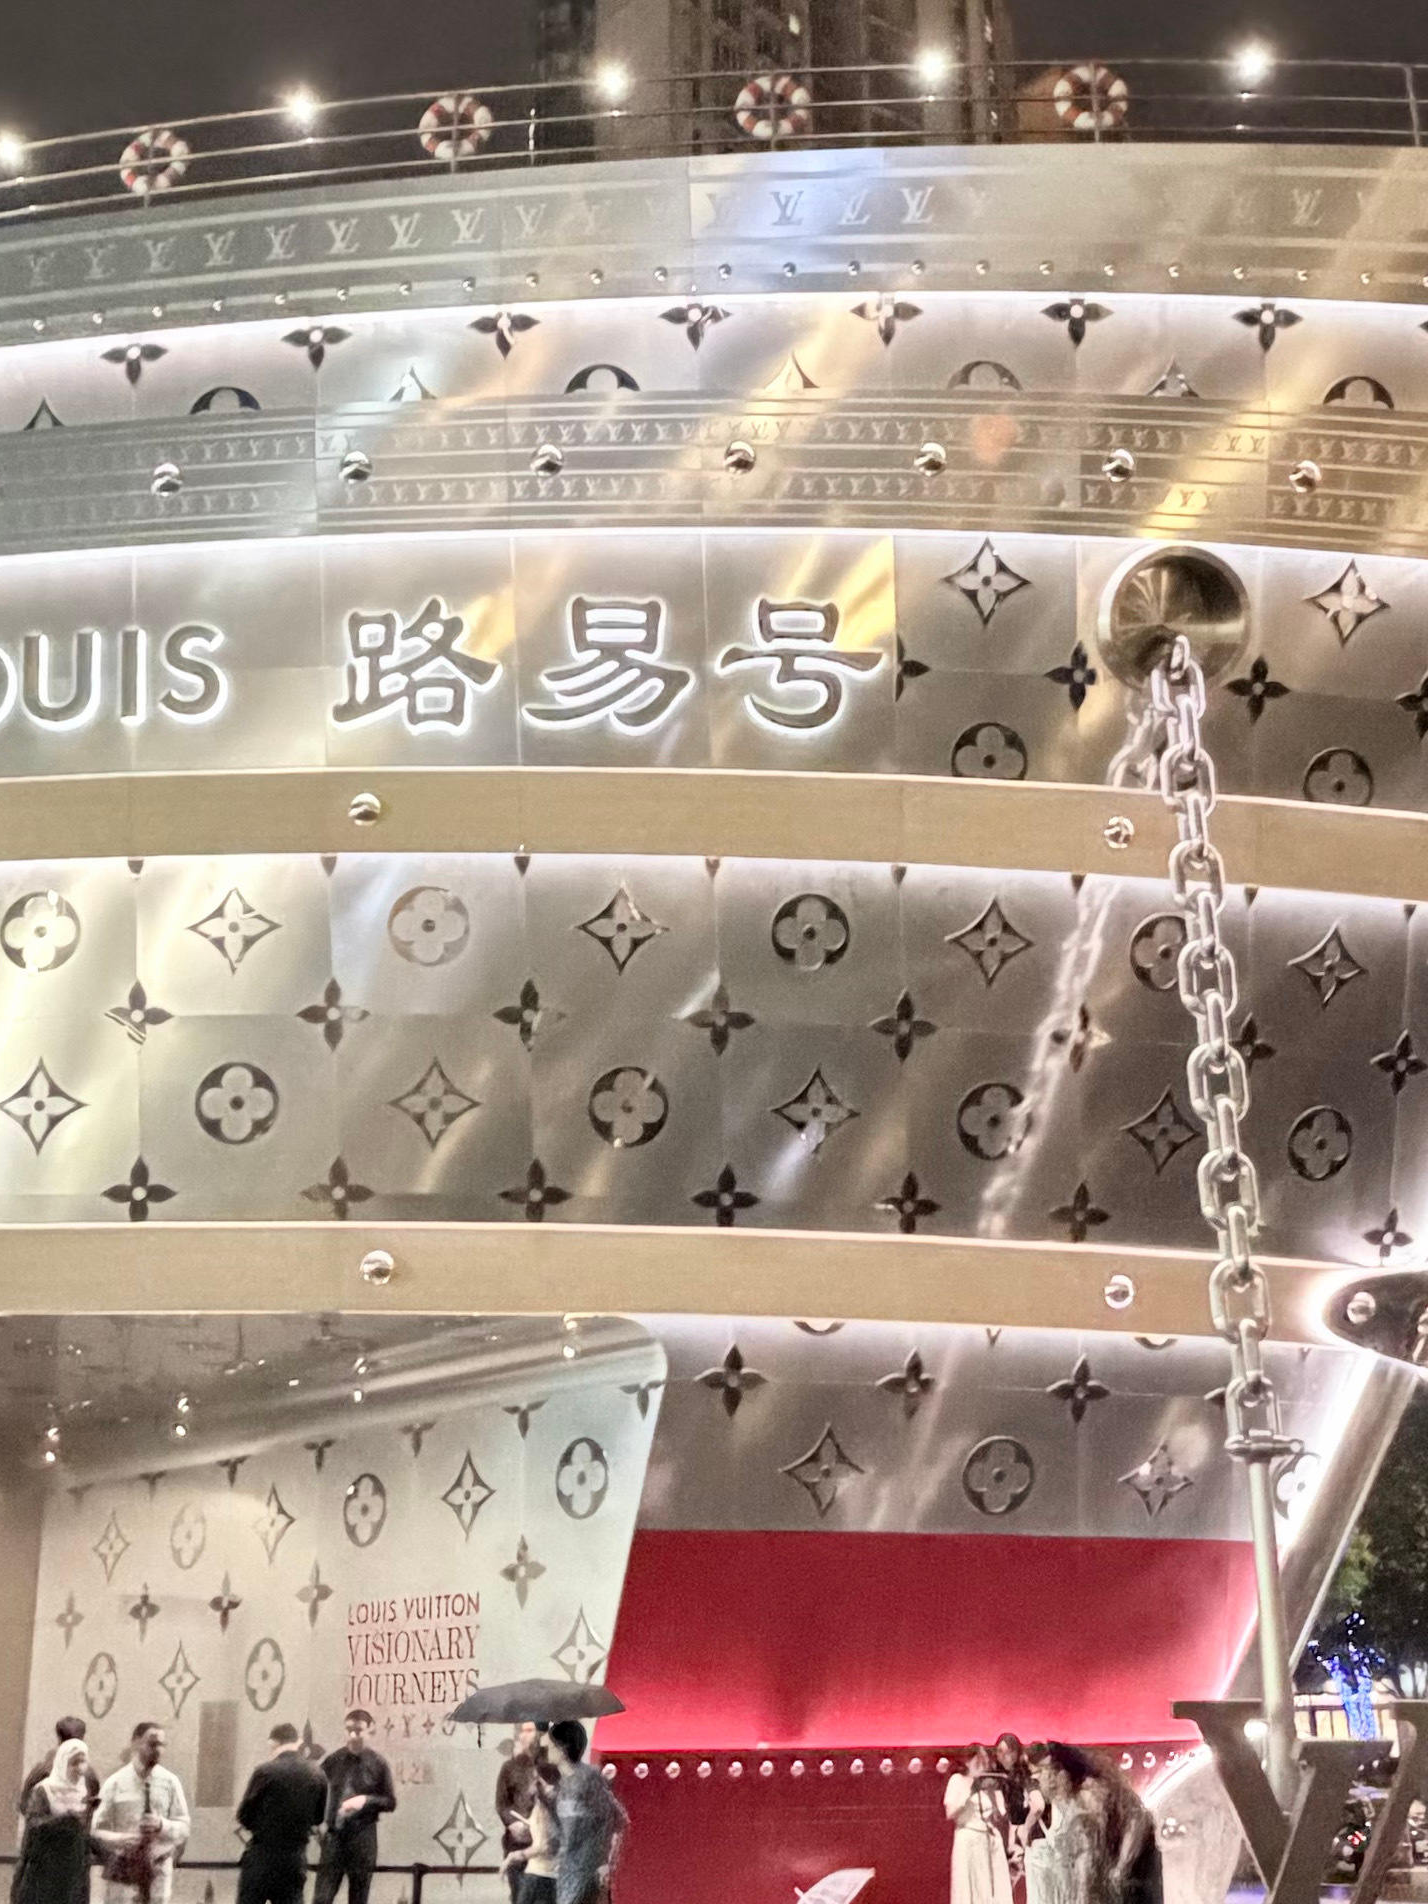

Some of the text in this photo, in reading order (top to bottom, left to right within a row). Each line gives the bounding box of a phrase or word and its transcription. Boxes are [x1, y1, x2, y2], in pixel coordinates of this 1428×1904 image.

[332, 594, 884, 738] 路易号
[348, 1592, 480, 1625] LOUIS VUITTON
[347, 1625, 480, 1667] VISIONARY
[345, 1668, 480, 1707] JOURNEYS
